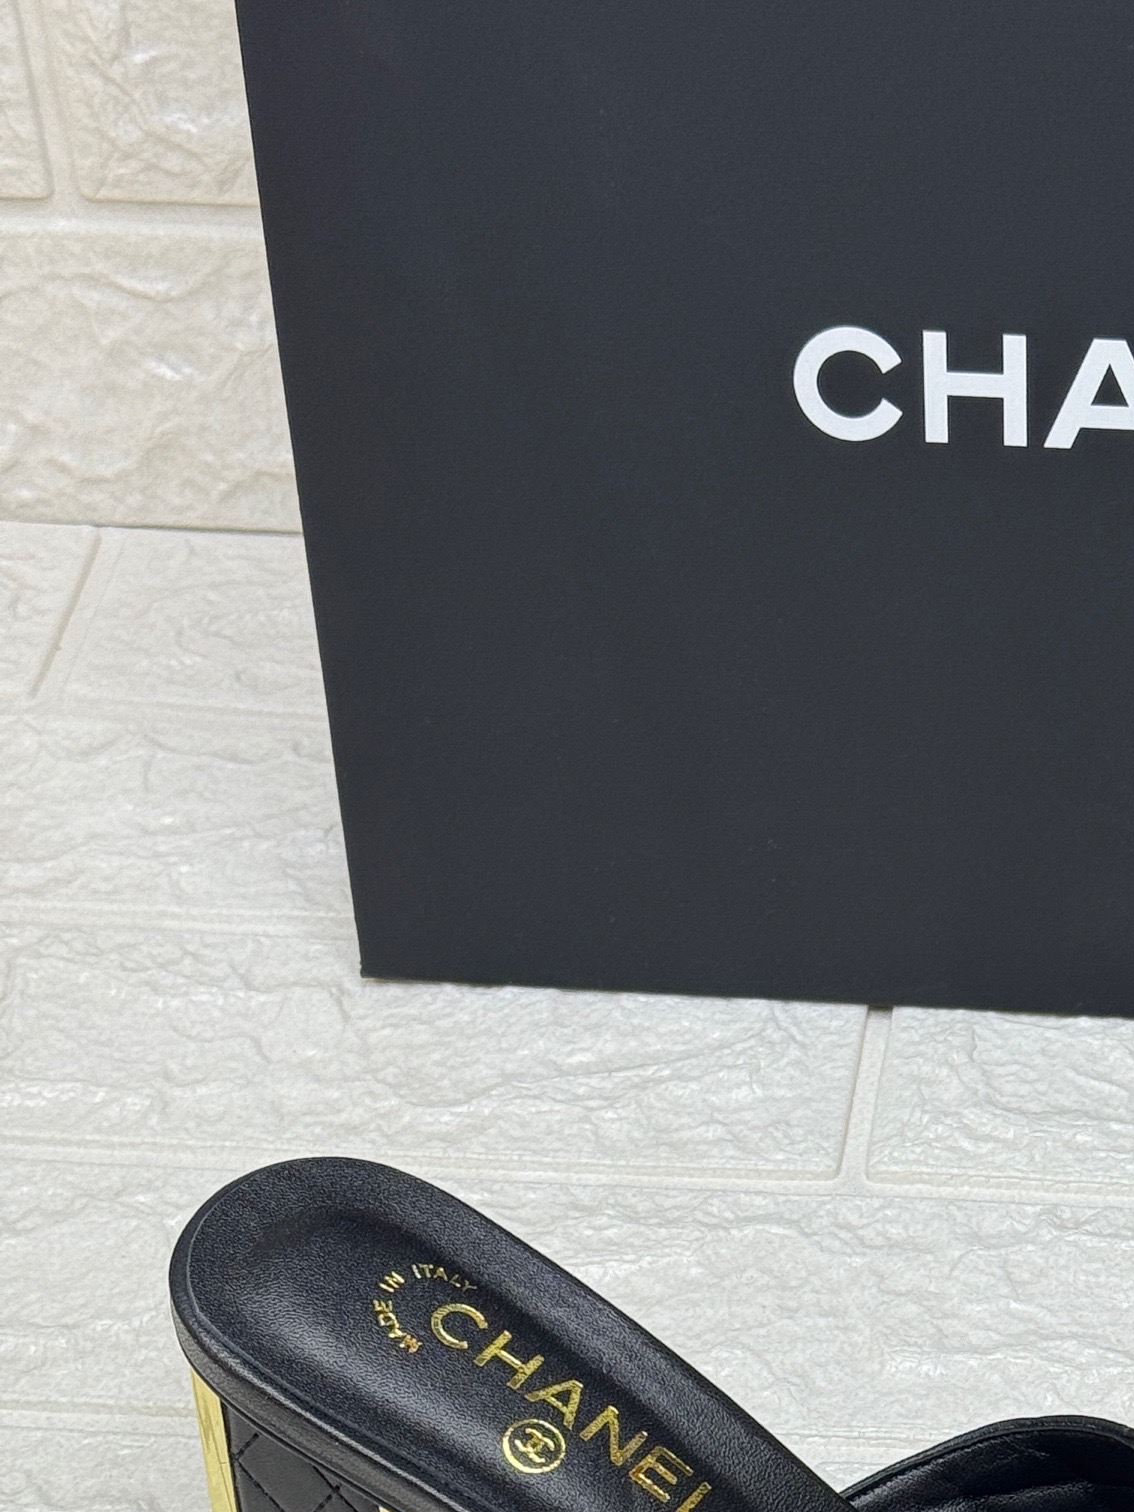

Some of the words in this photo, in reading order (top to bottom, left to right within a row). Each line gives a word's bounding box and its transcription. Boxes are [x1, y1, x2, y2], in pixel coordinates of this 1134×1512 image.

[378, 1270, 406, 1293] IN
[411, 1263, 478, 1296] ITALY
[373, 1299, 423, 1354] MADE
